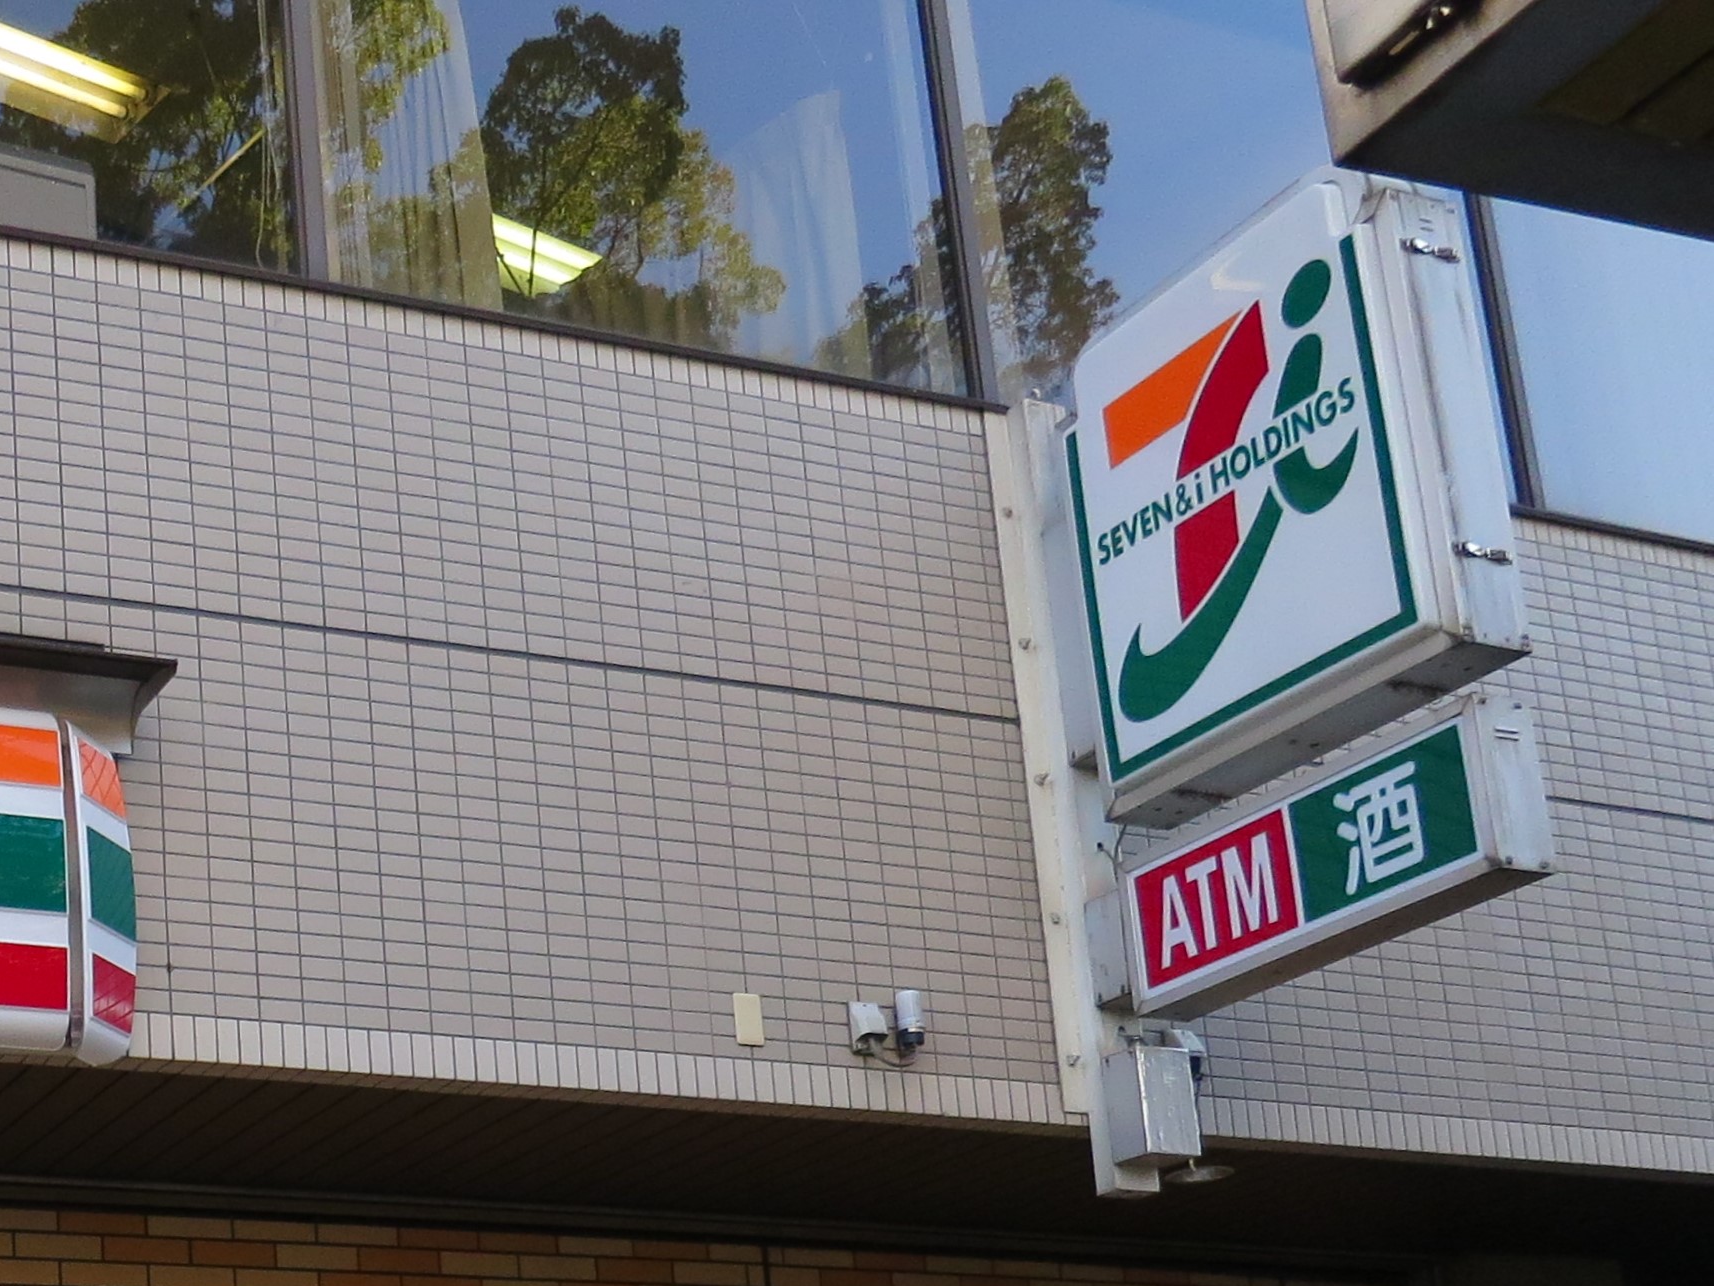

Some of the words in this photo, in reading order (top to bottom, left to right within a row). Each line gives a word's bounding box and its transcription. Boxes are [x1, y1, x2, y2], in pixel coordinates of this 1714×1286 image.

[1210, 376, 1356, 488] HOLDINGS
[1335, 760, 1424, 897] 酒
[1160, 828, 1279, 970] ATM
